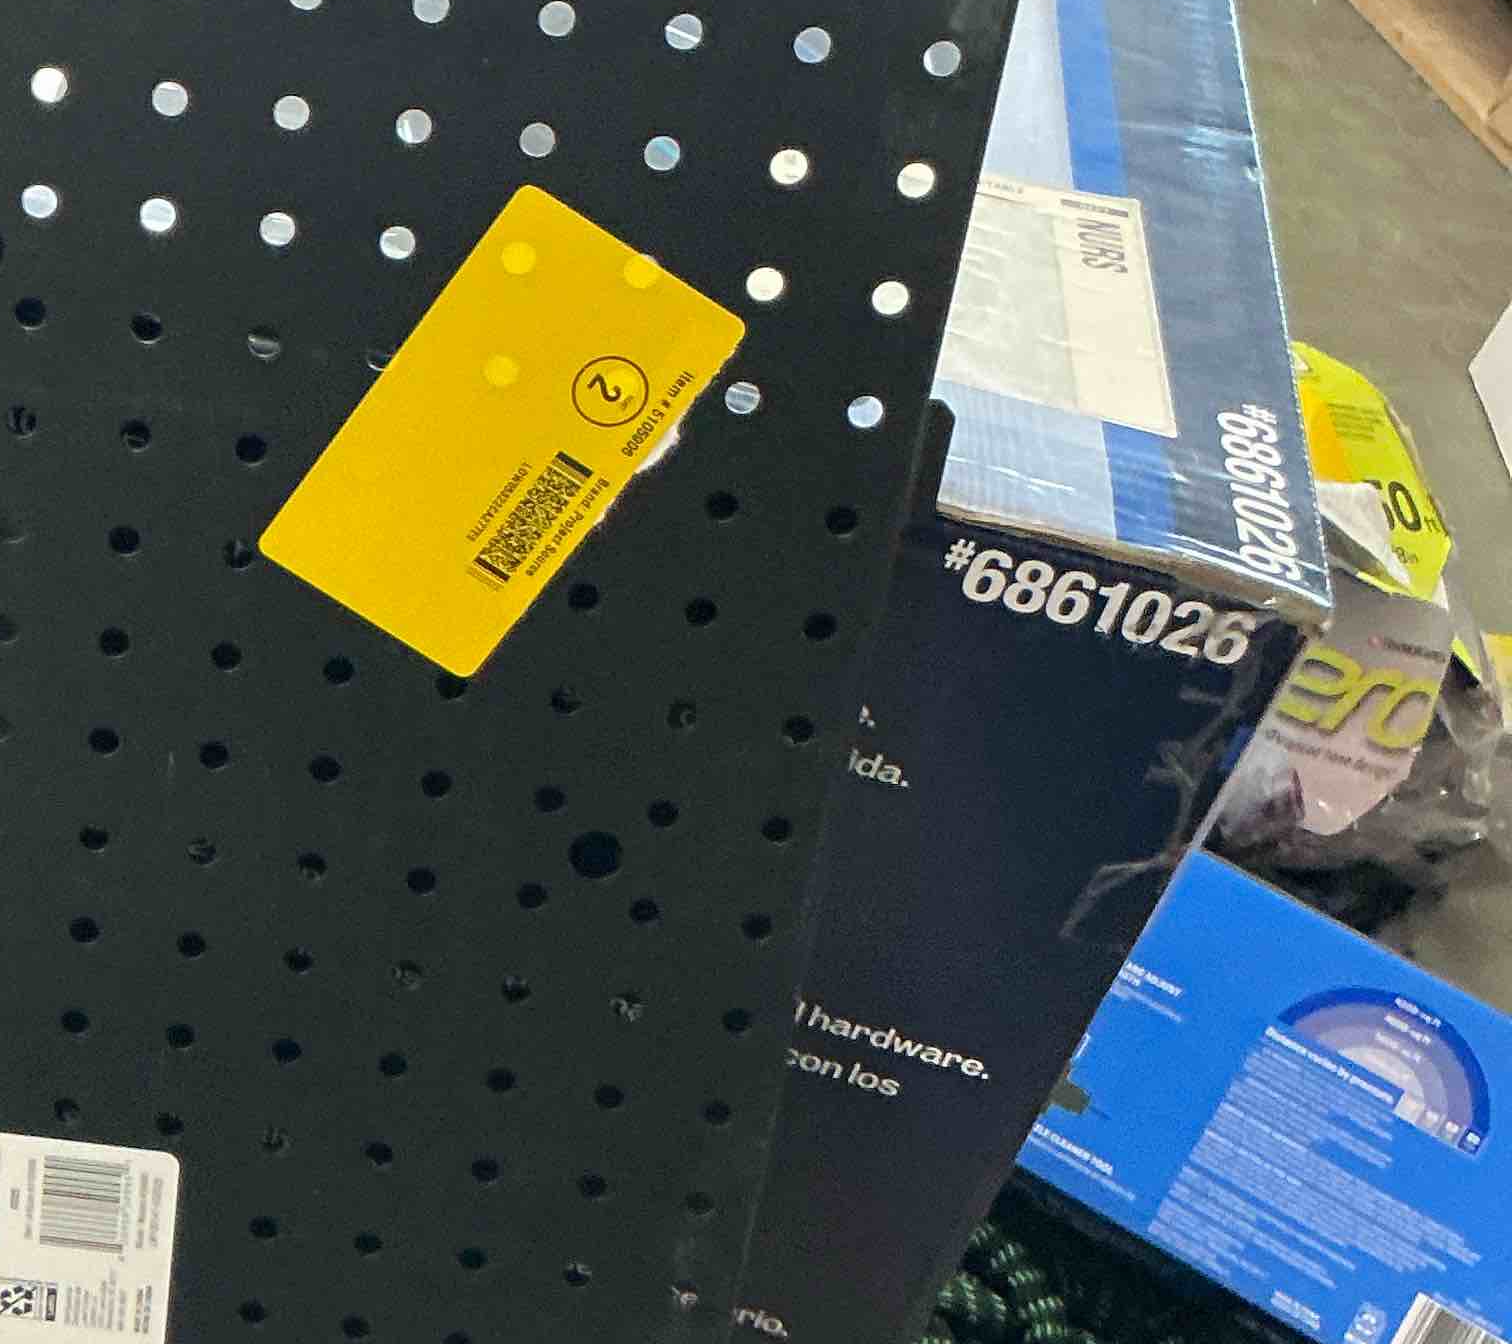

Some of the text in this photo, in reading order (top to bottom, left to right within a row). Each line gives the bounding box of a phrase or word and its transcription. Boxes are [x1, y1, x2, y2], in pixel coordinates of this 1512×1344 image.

[588, 373, 622, 403] 2
[668, 370, 695, 399] Item
[1362, 480, 1422, 532] 0
[551, 511, 584, 547] Project
[526, 544, 557, 577] Source
[944, 537, 1256, 665] #6861026
[808, 1004, 988, 1080] hardware.
[848, 1063, 901, 1096] los
